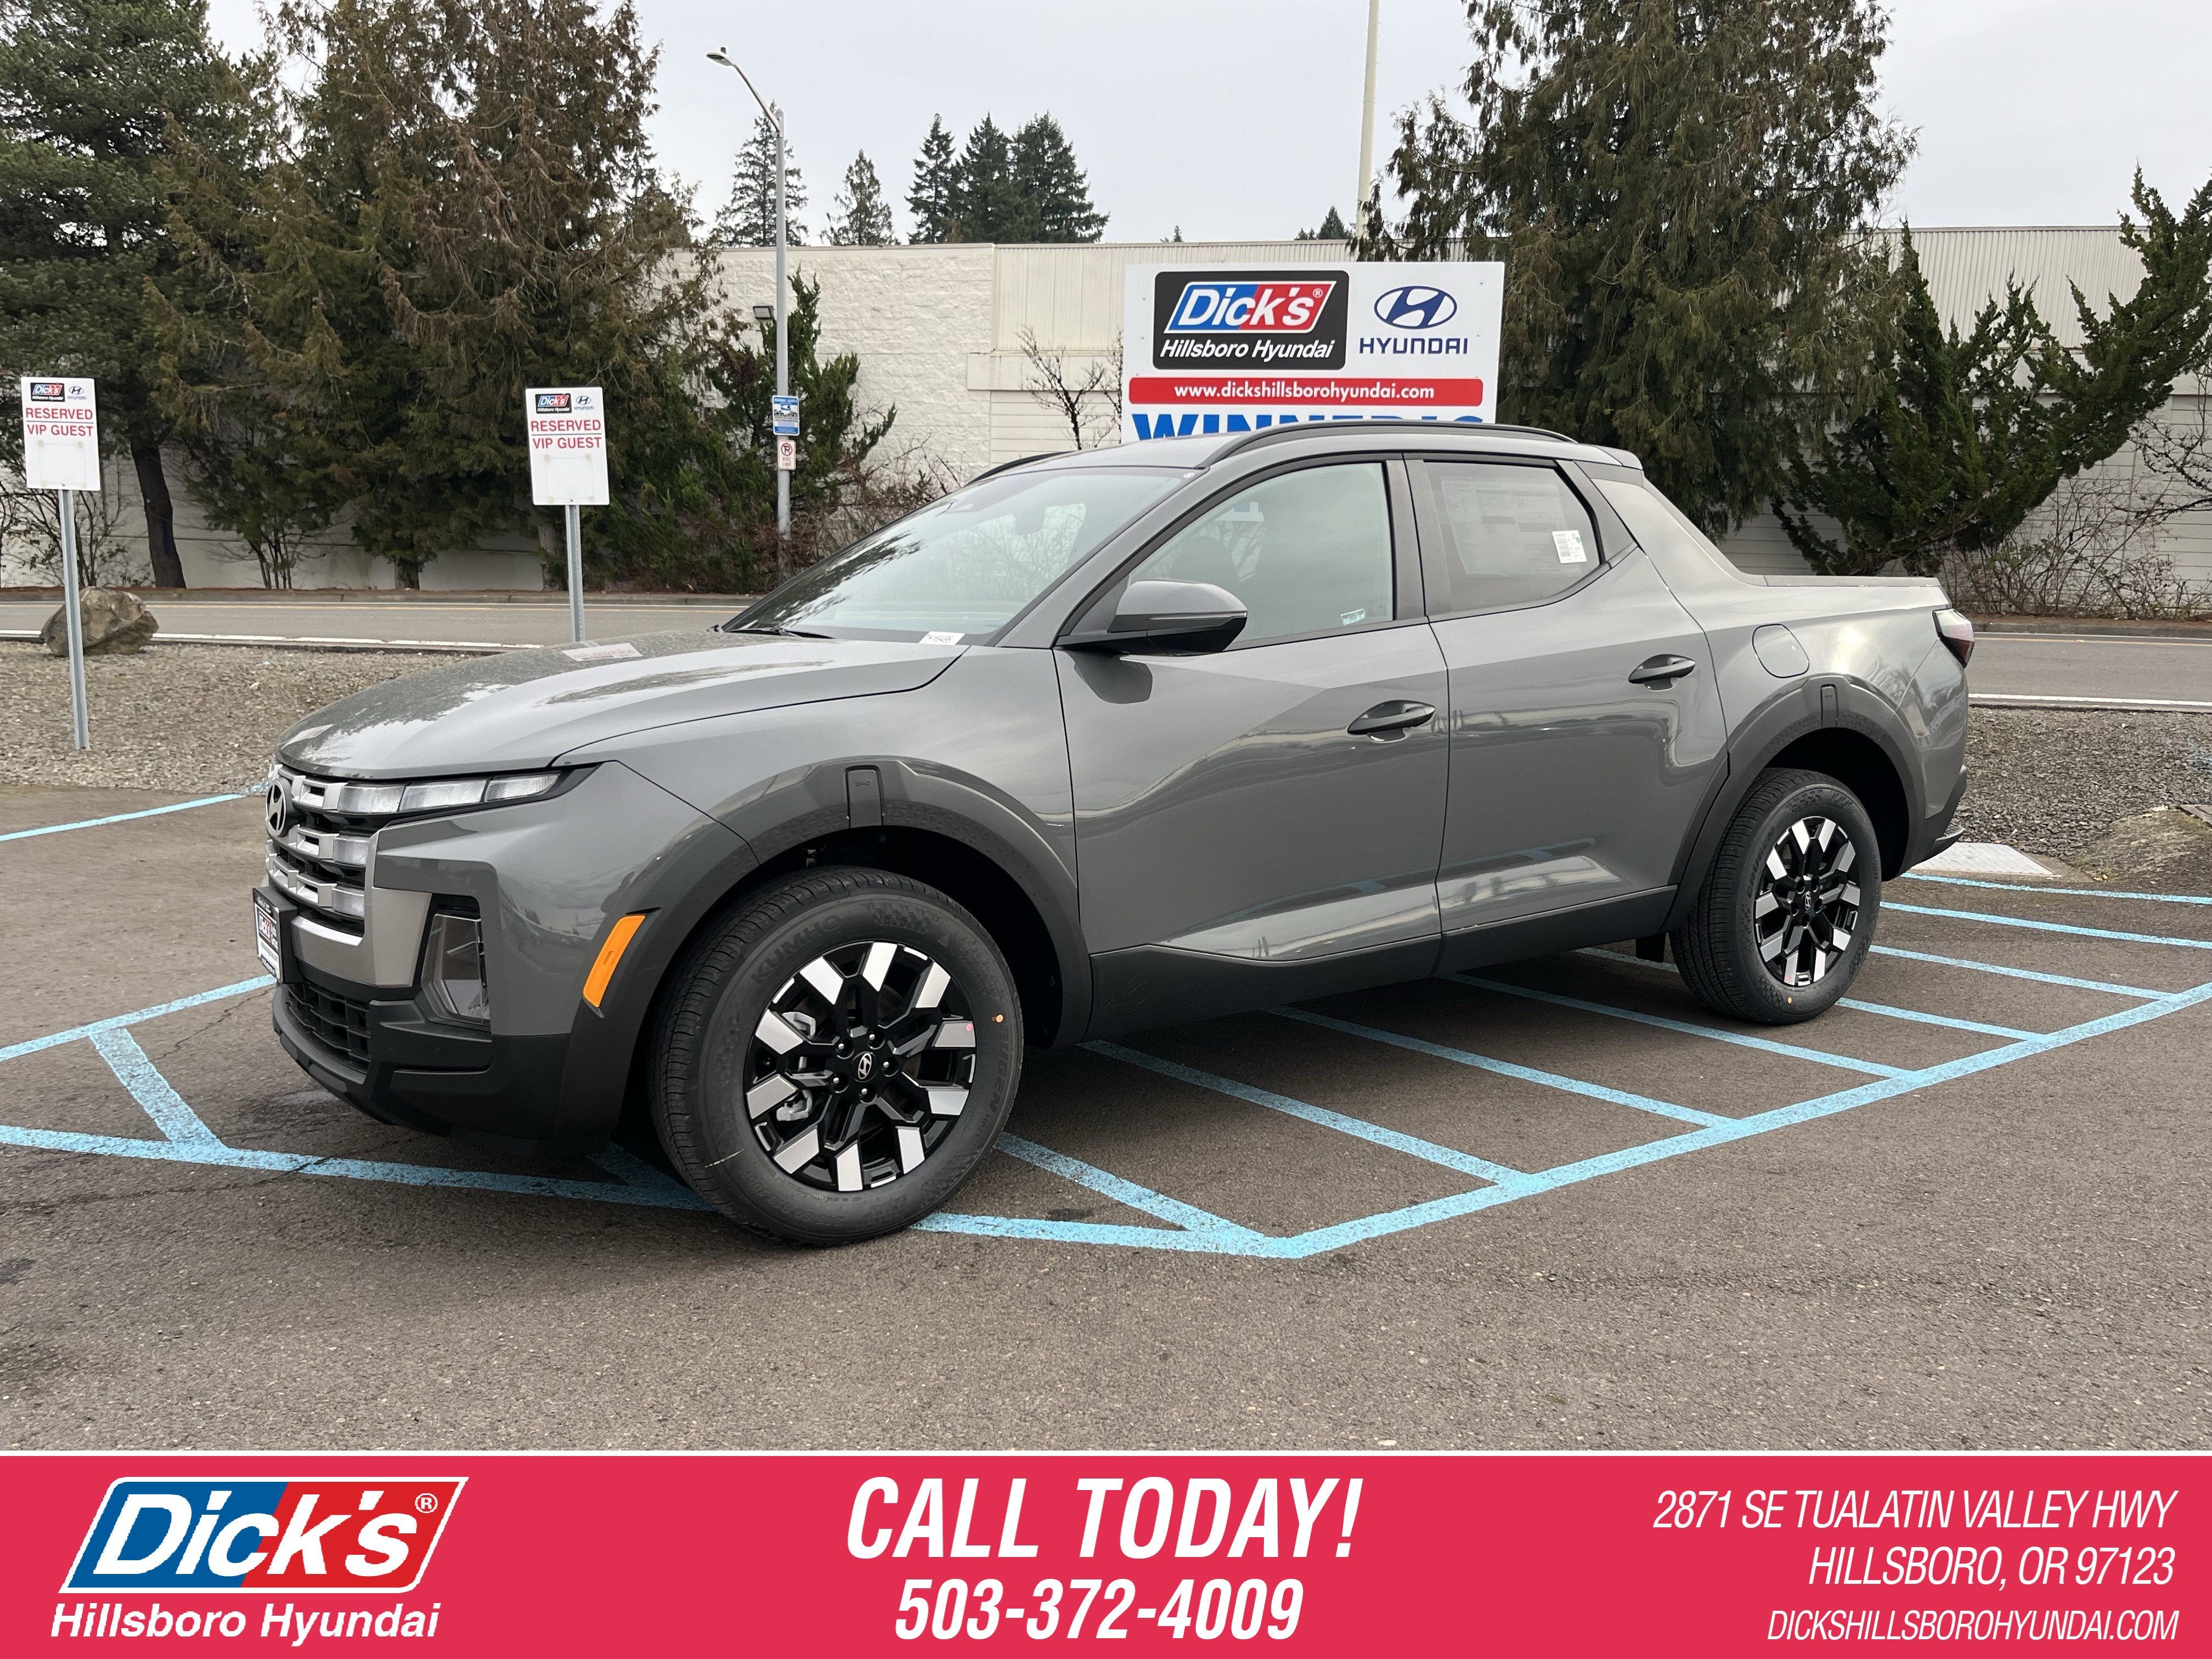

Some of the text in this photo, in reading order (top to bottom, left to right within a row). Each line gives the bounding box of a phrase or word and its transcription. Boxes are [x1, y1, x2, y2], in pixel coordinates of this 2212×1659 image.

[1160, 339, 1335, 362] Hillsboro Hyundai
[1359, 337, 1468, 354] HYUNDAI
[1174, 381, 1435, 403] www.dickshillsborohyundai.com
[25, 408, 93, 420] RESERVED
[27, 424, 94, 437] VIP GUEST
[531, 420, 601, 432] RESERVED
[533, 437, 602, 449] VIP GUEST
[751, 915, 844, 986] KUMHO
